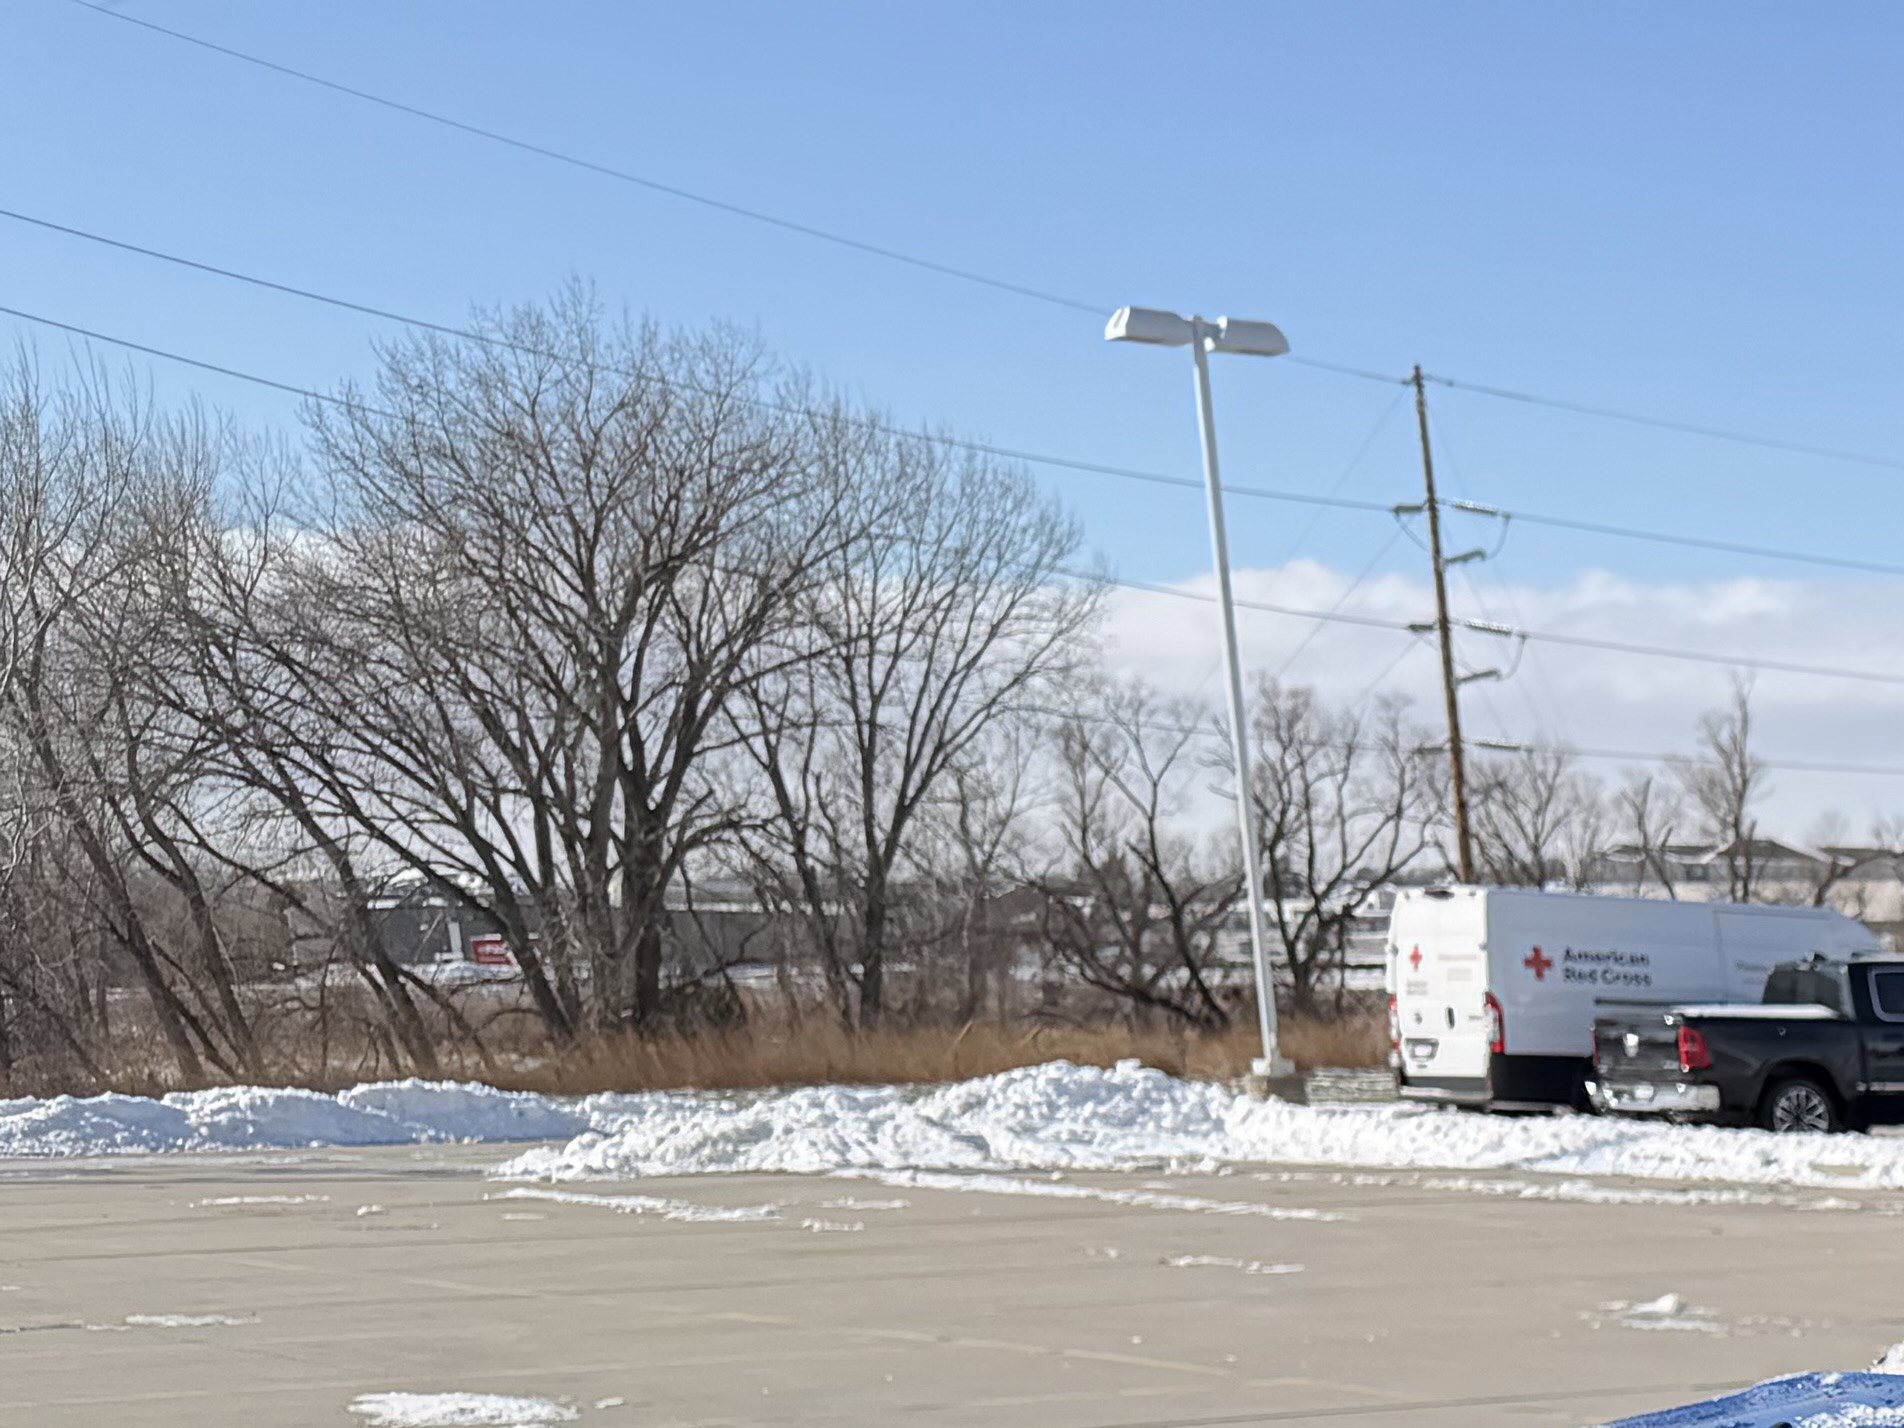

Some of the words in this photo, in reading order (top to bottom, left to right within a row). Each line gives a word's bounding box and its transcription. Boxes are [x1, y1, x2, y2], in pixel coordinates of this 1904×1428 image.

[1564, 947, 1650, 966] American
[1563, 967, 1598, 985] Red
[1601, 967, 1652, 987] Cross
